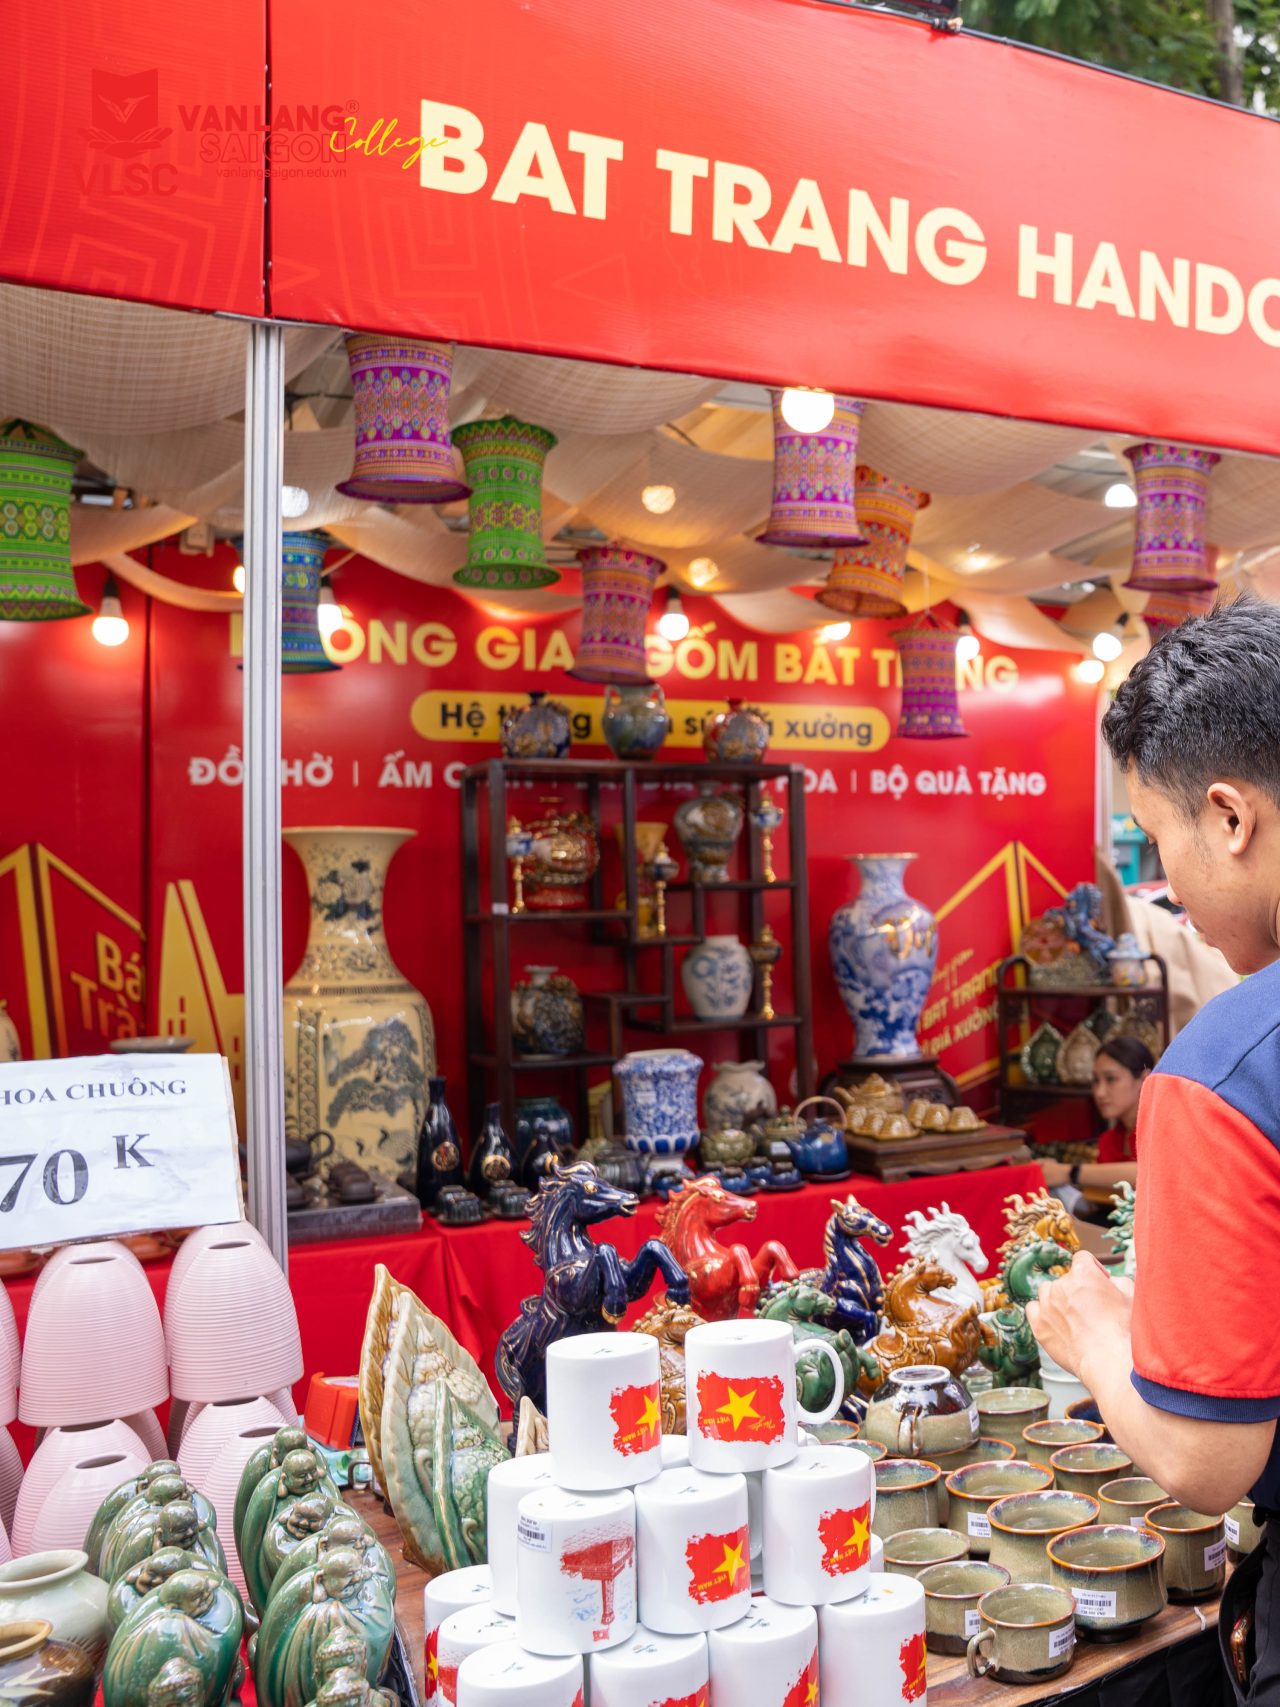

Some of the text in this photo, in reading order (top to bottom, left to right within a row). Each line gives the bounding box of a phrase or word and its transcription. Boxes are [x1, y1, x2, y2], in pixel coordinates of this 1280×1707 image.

[420, 99, 623, 220] BAT
[656, 149, 987, 285] TRANG
[475, 626, 575, 671] GIA
[441, 702, 487, 737] Hệ
[281, 752, 334, 787] HỜ
[65, 1077, 187, 1101] CHUÔNG
[112, 1133, 155, 1170] K
